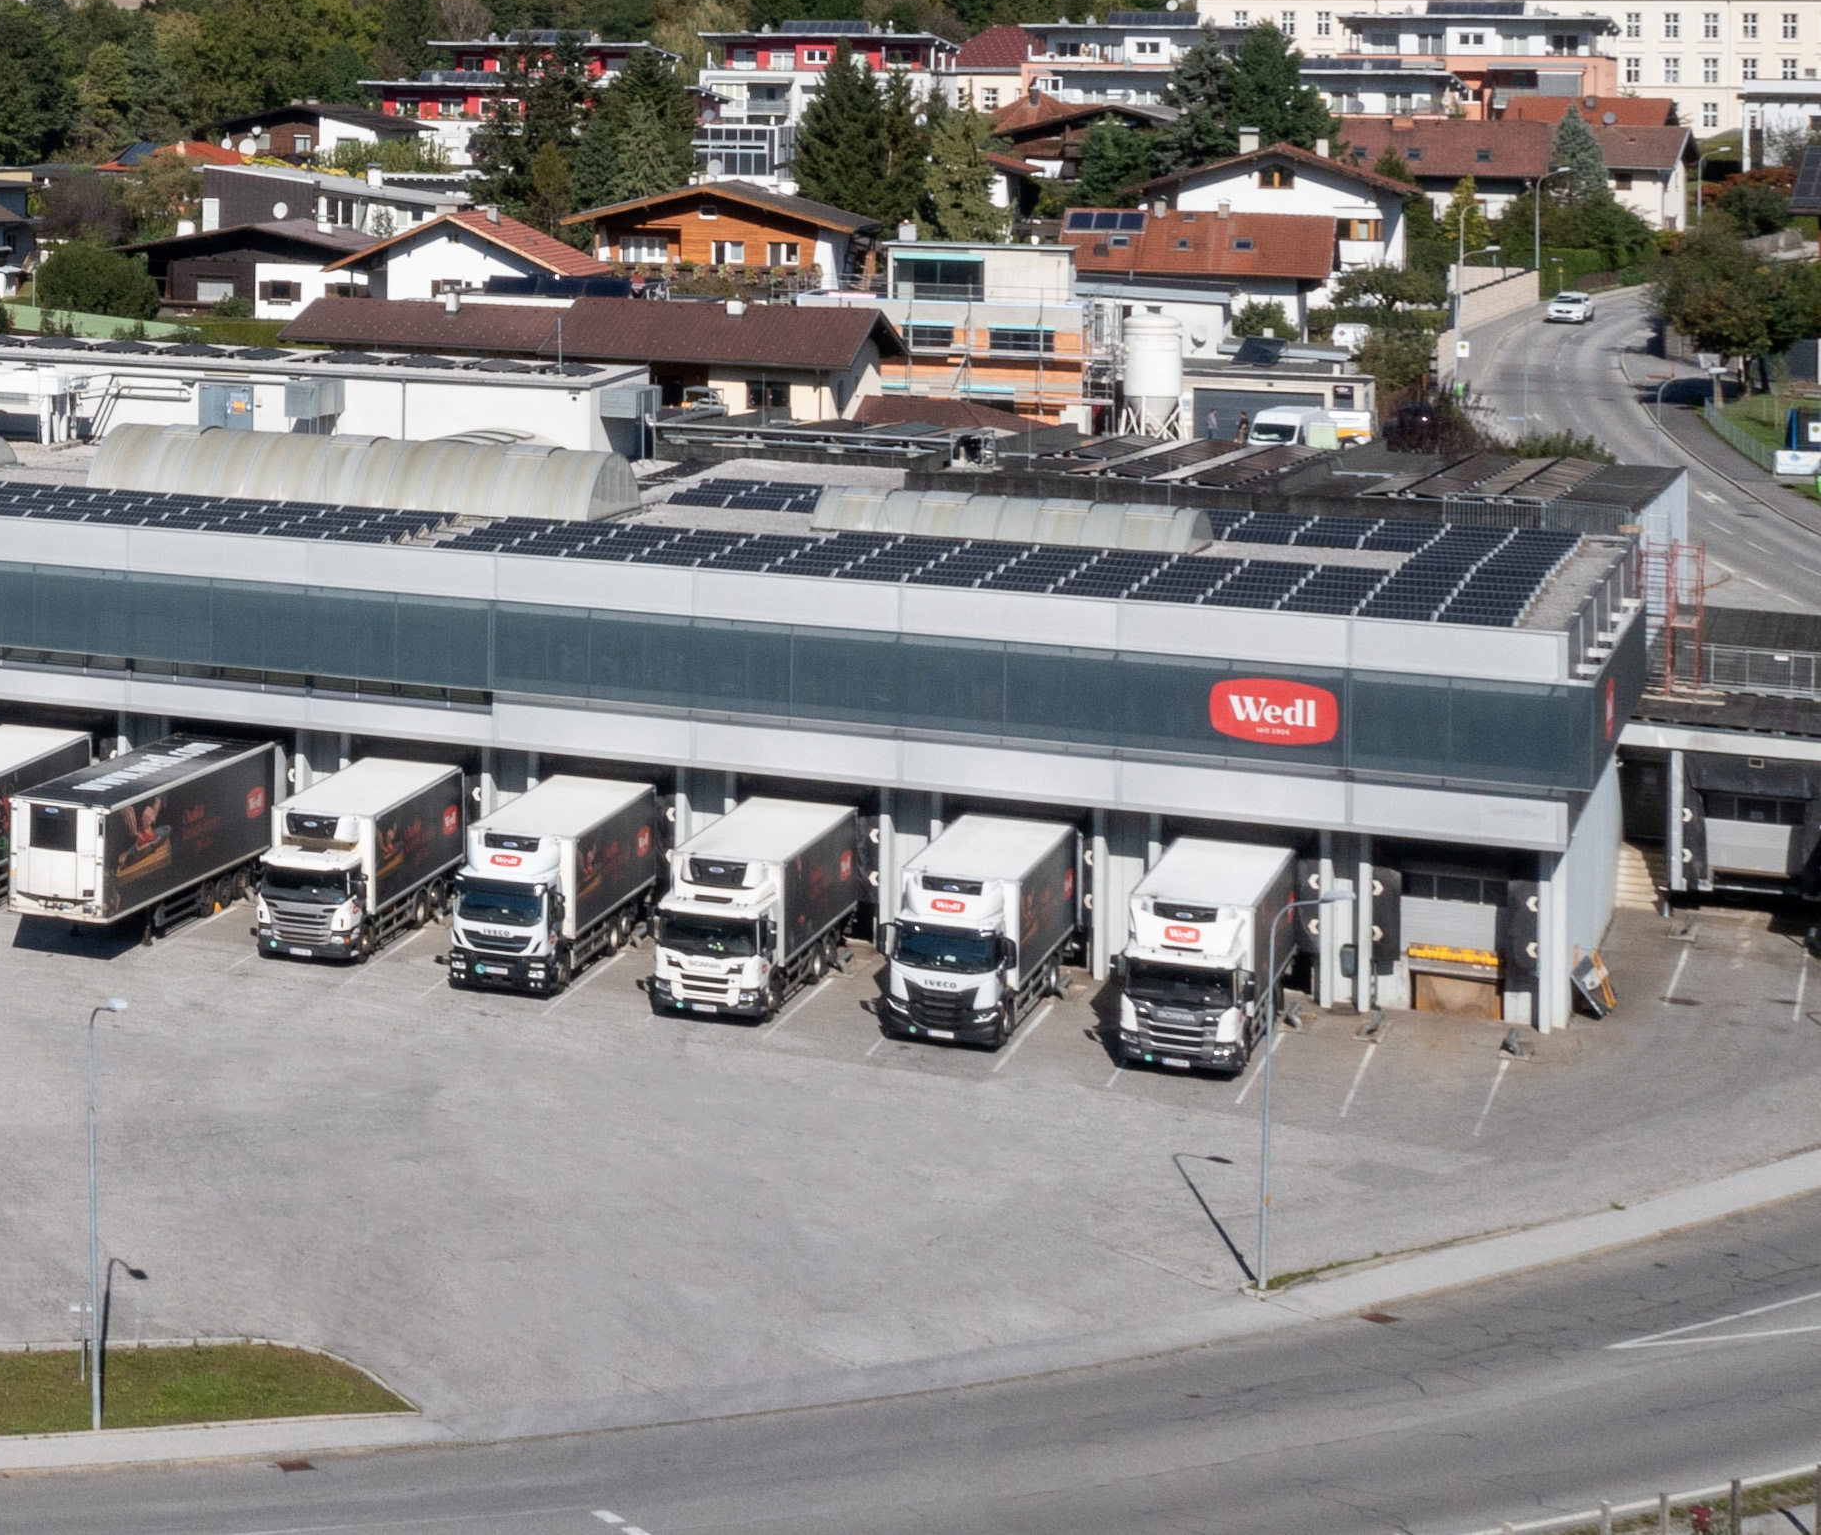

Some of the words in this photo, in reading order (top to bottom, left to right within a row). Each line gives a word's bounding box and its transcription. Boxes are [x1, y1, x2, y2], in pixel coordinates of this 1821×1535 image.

[1228, 694, 1316, 727] Wedl
[483, 928, 510, 937] IVECO
[687, 960, 721, 969] SCANIA
[924, 979, 957, 989] IVECO
